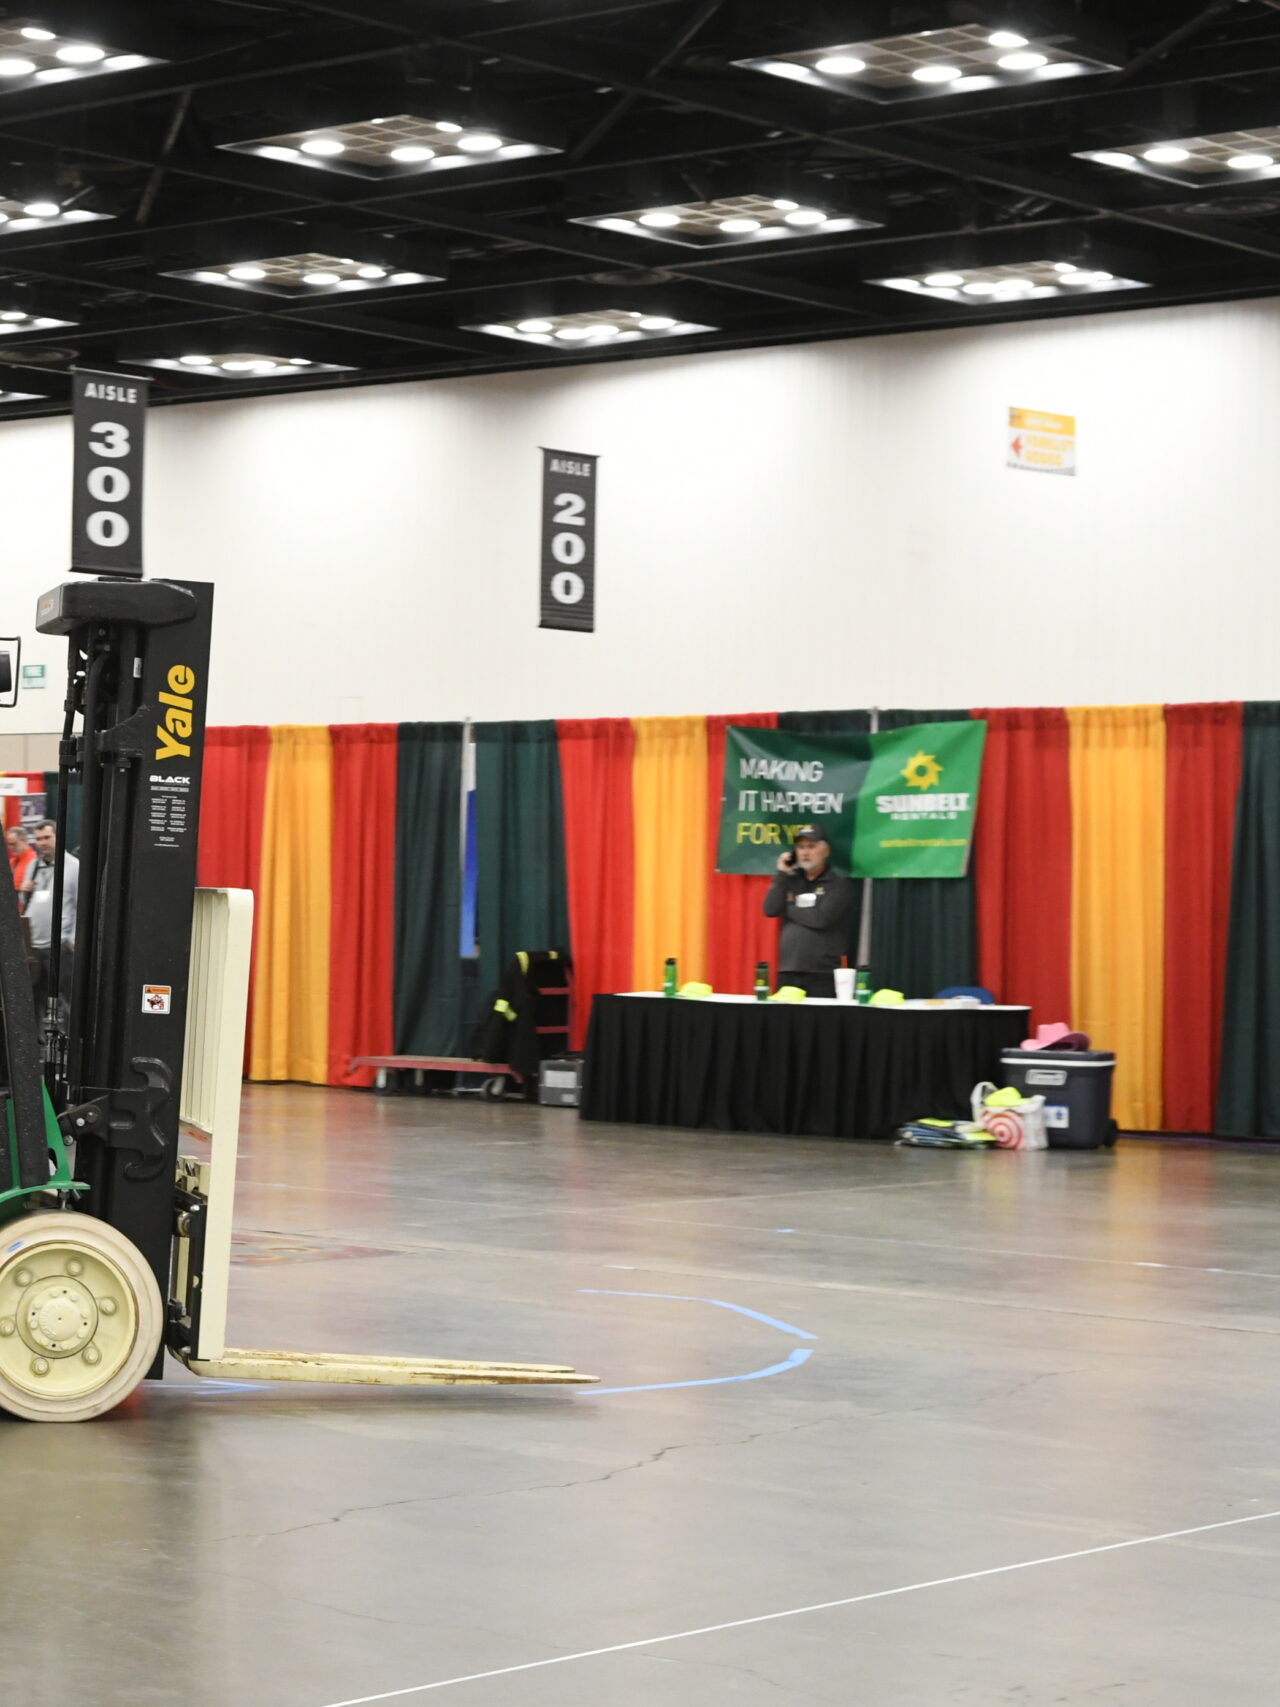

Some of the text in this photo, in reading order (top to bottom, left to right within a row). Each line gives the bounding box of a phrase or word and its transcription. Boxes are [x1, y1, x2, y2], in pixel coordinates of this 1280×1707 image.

[84, 382, 137, 403] AISLE
[549, 458, 591, 477] AISLE
[85, 421, 131, 547] 300
[550, 492, 586, 604] 200
[155, 664, 195, 760] Yale
[739, 757, 824, 782] MAKING
[738, 790, 844, 814] IT HAPPEN
[735, 822, 782, 845] FOR
